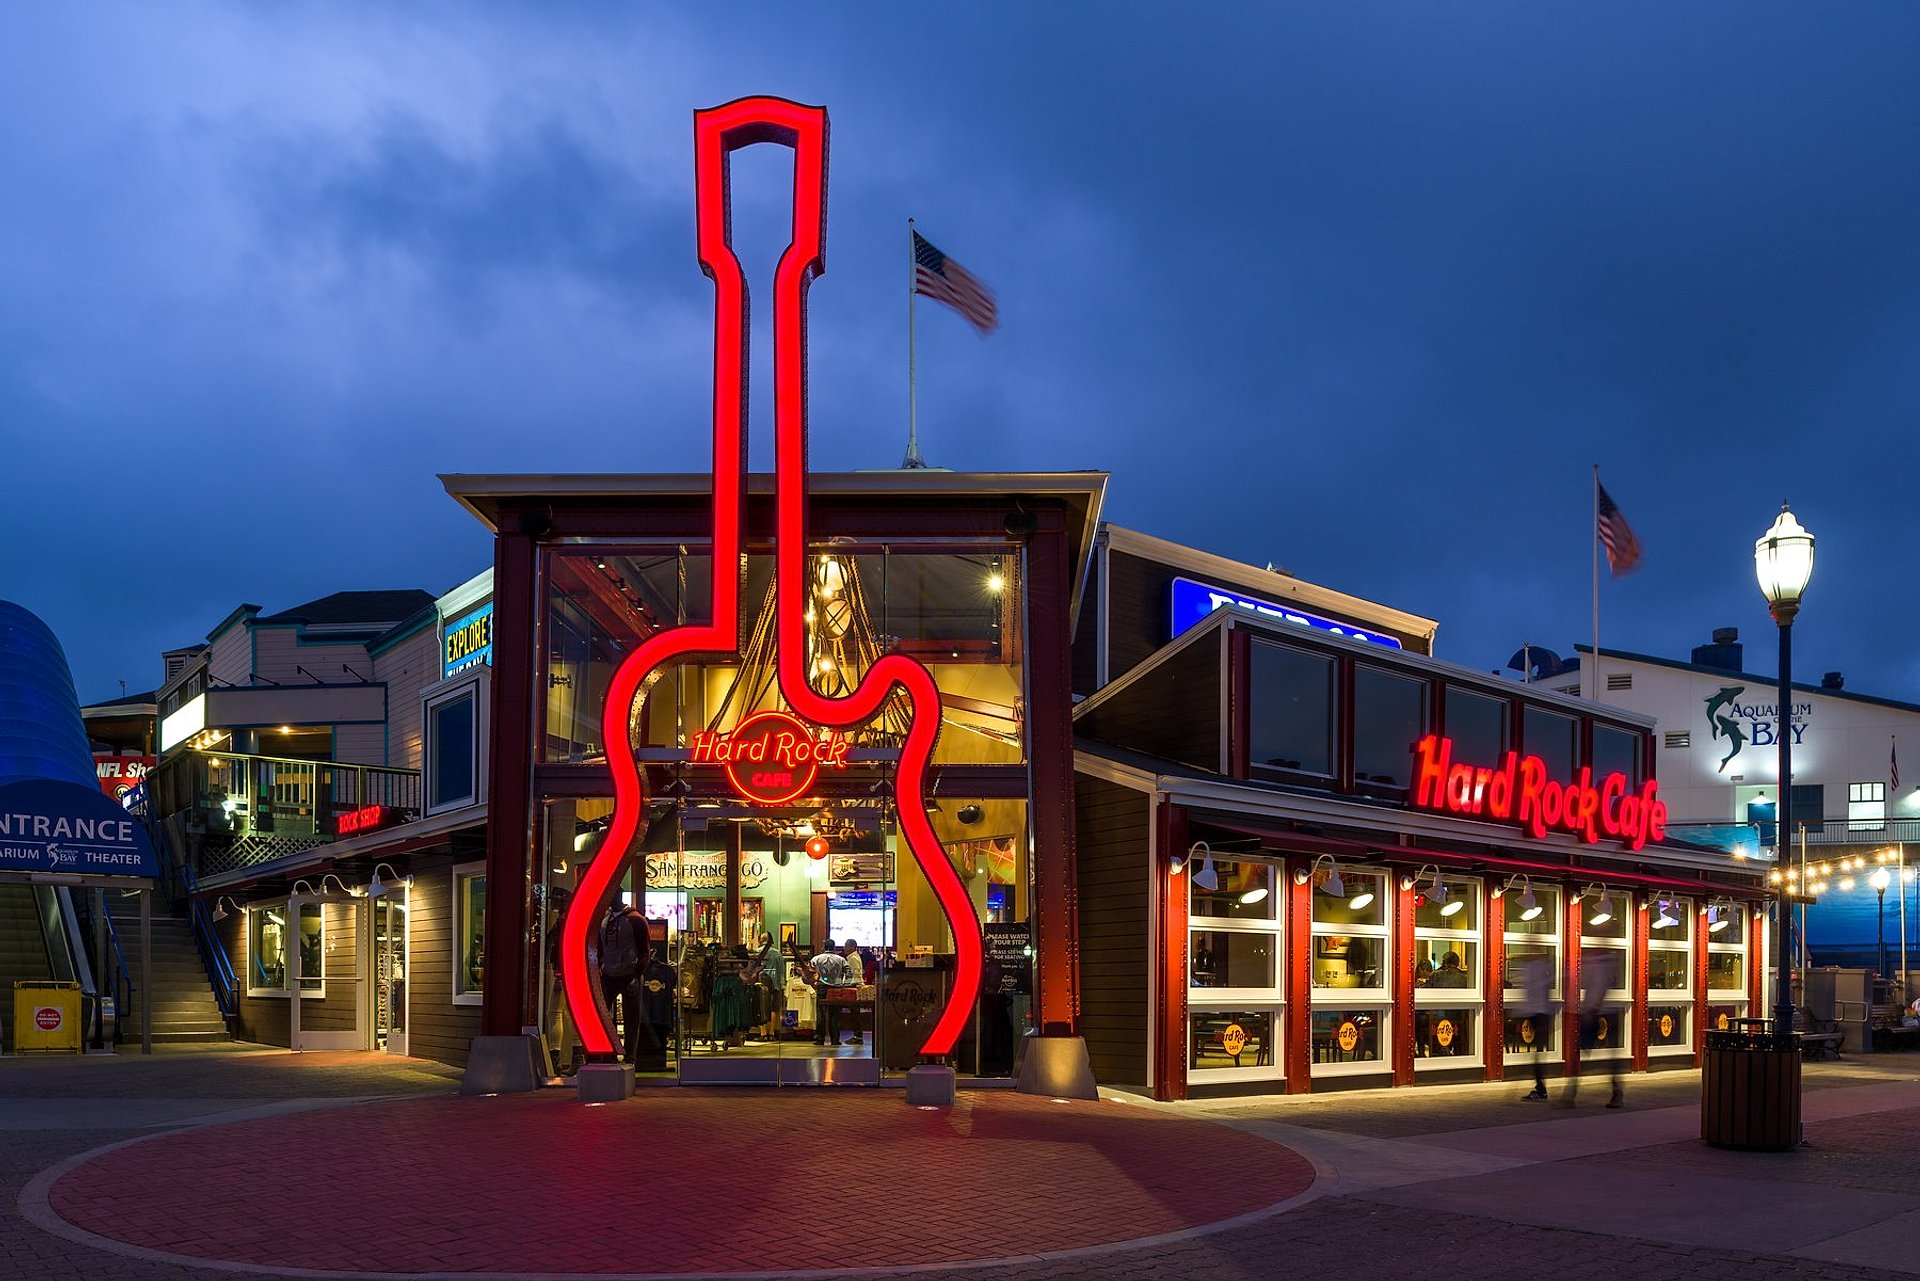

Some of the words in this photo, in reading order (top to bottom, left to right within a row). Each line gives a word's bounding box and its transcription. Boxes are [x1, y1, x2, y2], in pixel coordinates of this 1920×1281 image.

[447, 617, 487, 663] EXPLORE
[1730, 704, 1812, 721] AQUAUM
[692, 732, 769, 761] Hard
[775, 732, 847, 767] Rock
[96, 762, 122, 778] NFL
[752, 773, 793, 787] CAFE
[1416, 735, 1517, 818] Hard
[1519, 755, 1599, 844] Rock
[1602, 771, 1667, 851] Cafe
[339, 811, 359, 833] ROCK
[360, 805, 380, 828] SHOP
[0, 848, 39, 860] RIUM
[85, 852, 141, 865] THEATER
[646, 858, 677, 878] SAN
[681, 861, 763, 877] FRANCCO
